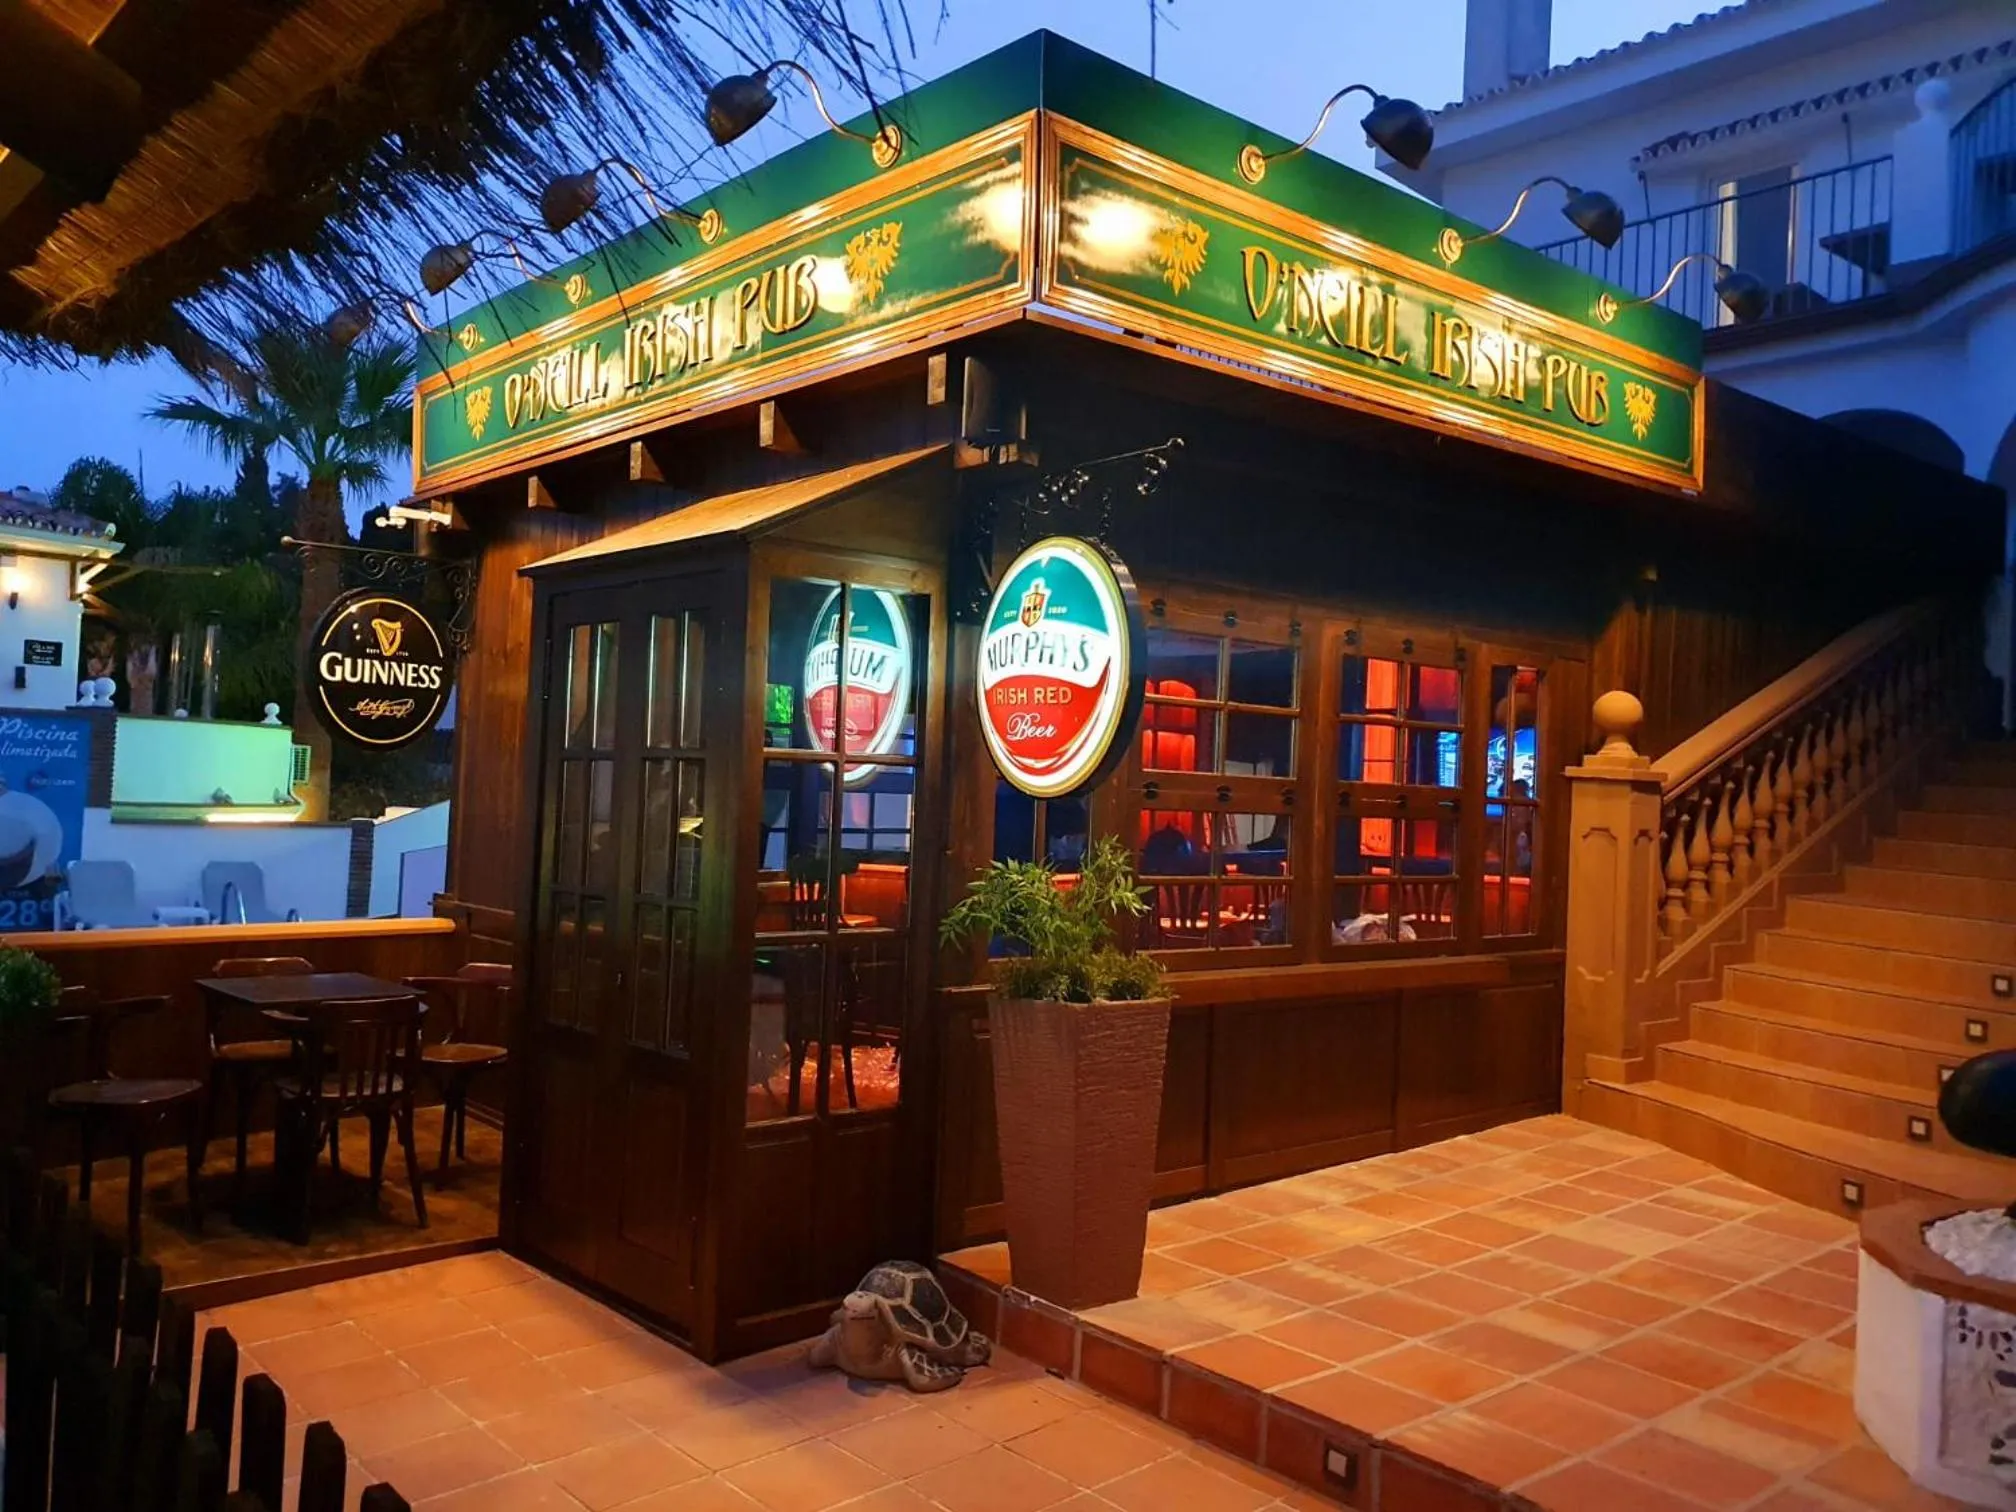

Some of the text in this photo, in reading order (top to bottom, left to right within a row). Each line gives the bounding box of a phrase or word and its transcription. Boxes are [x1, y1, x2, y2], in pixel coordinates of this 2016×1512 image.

[504, 254, 818, 428] O'NEILL IRISH PUB
[1242, 246, 1609, 427] O'NEILL IRISH PUB
[319, 652, 443, 689] GUINNESS
[993, 686, 1072, 705] IRISH RED
[0, 716, 79, 741] Piscina
[1007, 712, 1057, 740] Beer
[0, 741, 78, 764] limatizada
